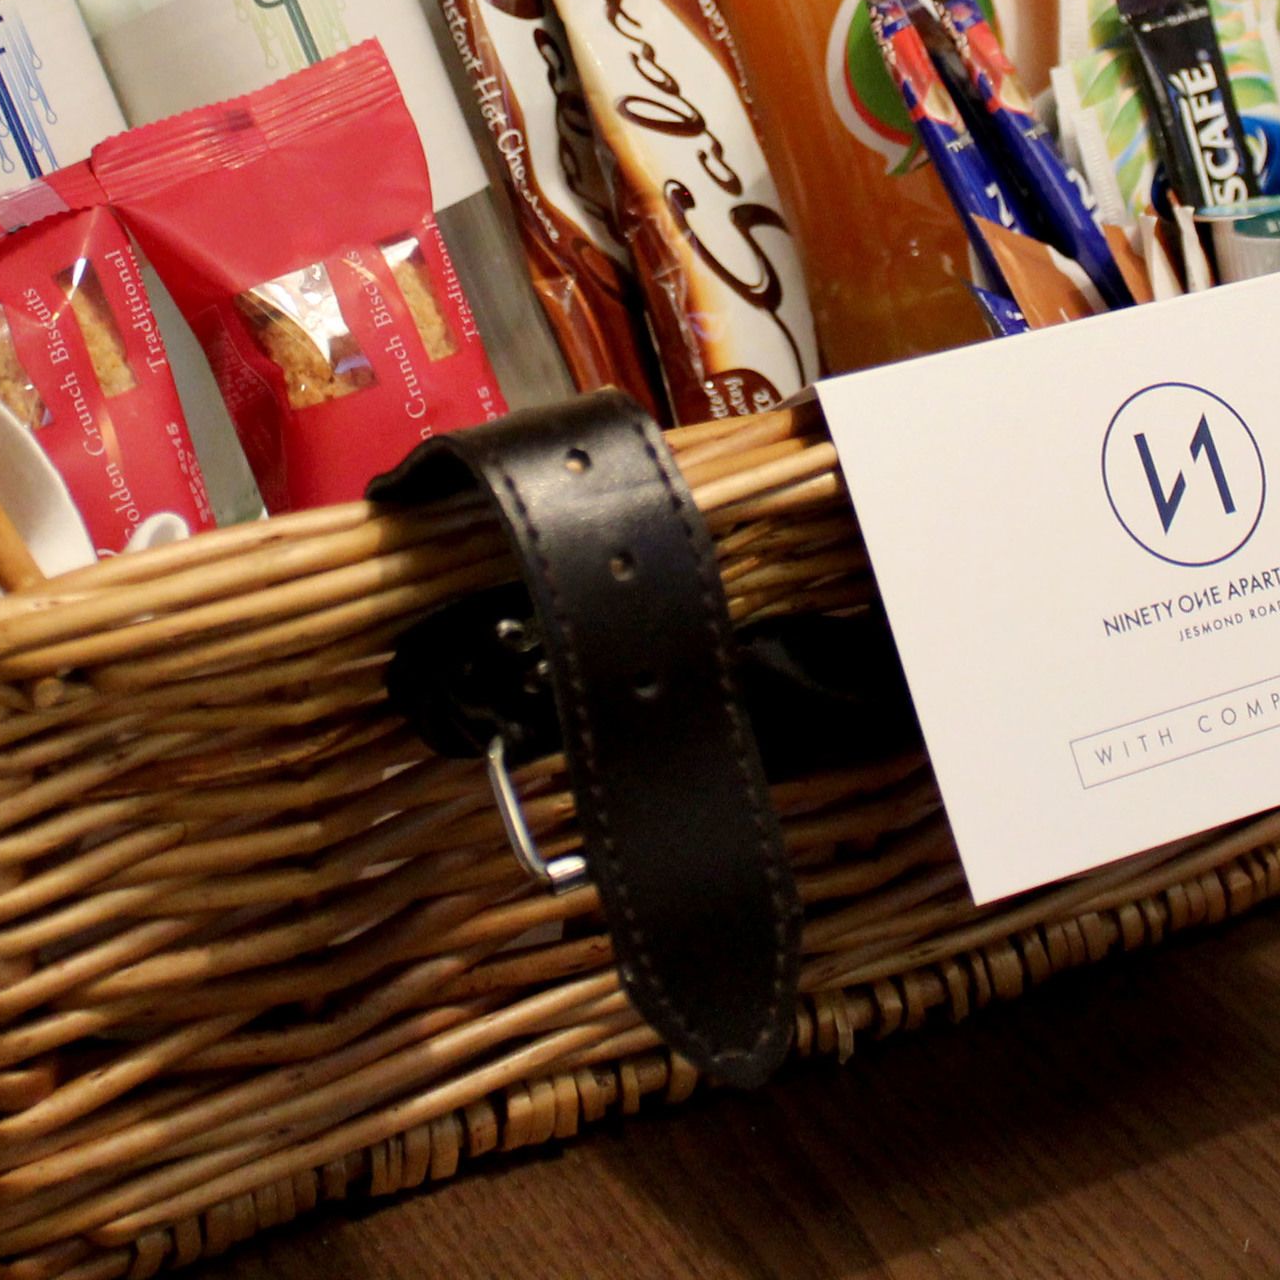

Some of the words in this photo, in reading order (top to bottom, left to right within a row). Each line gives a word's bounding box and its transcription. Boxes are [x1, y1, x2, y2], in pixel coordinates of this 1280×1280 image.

[473, 75, 508, 132] Hot
[22, 287, 70, 365] Biscuits
[104, 249, 166, 375] Traditional
[383, 334, 427, 420] Crunch
[59, 371, 106, 457] Crunch
[1103, 597, 1174, 637] NINETY
[1178, 584, 1222, 616] ONE
[1178, 611, 1244, 641] JESMOND
[1094, 726, 1175, 767] WITH
